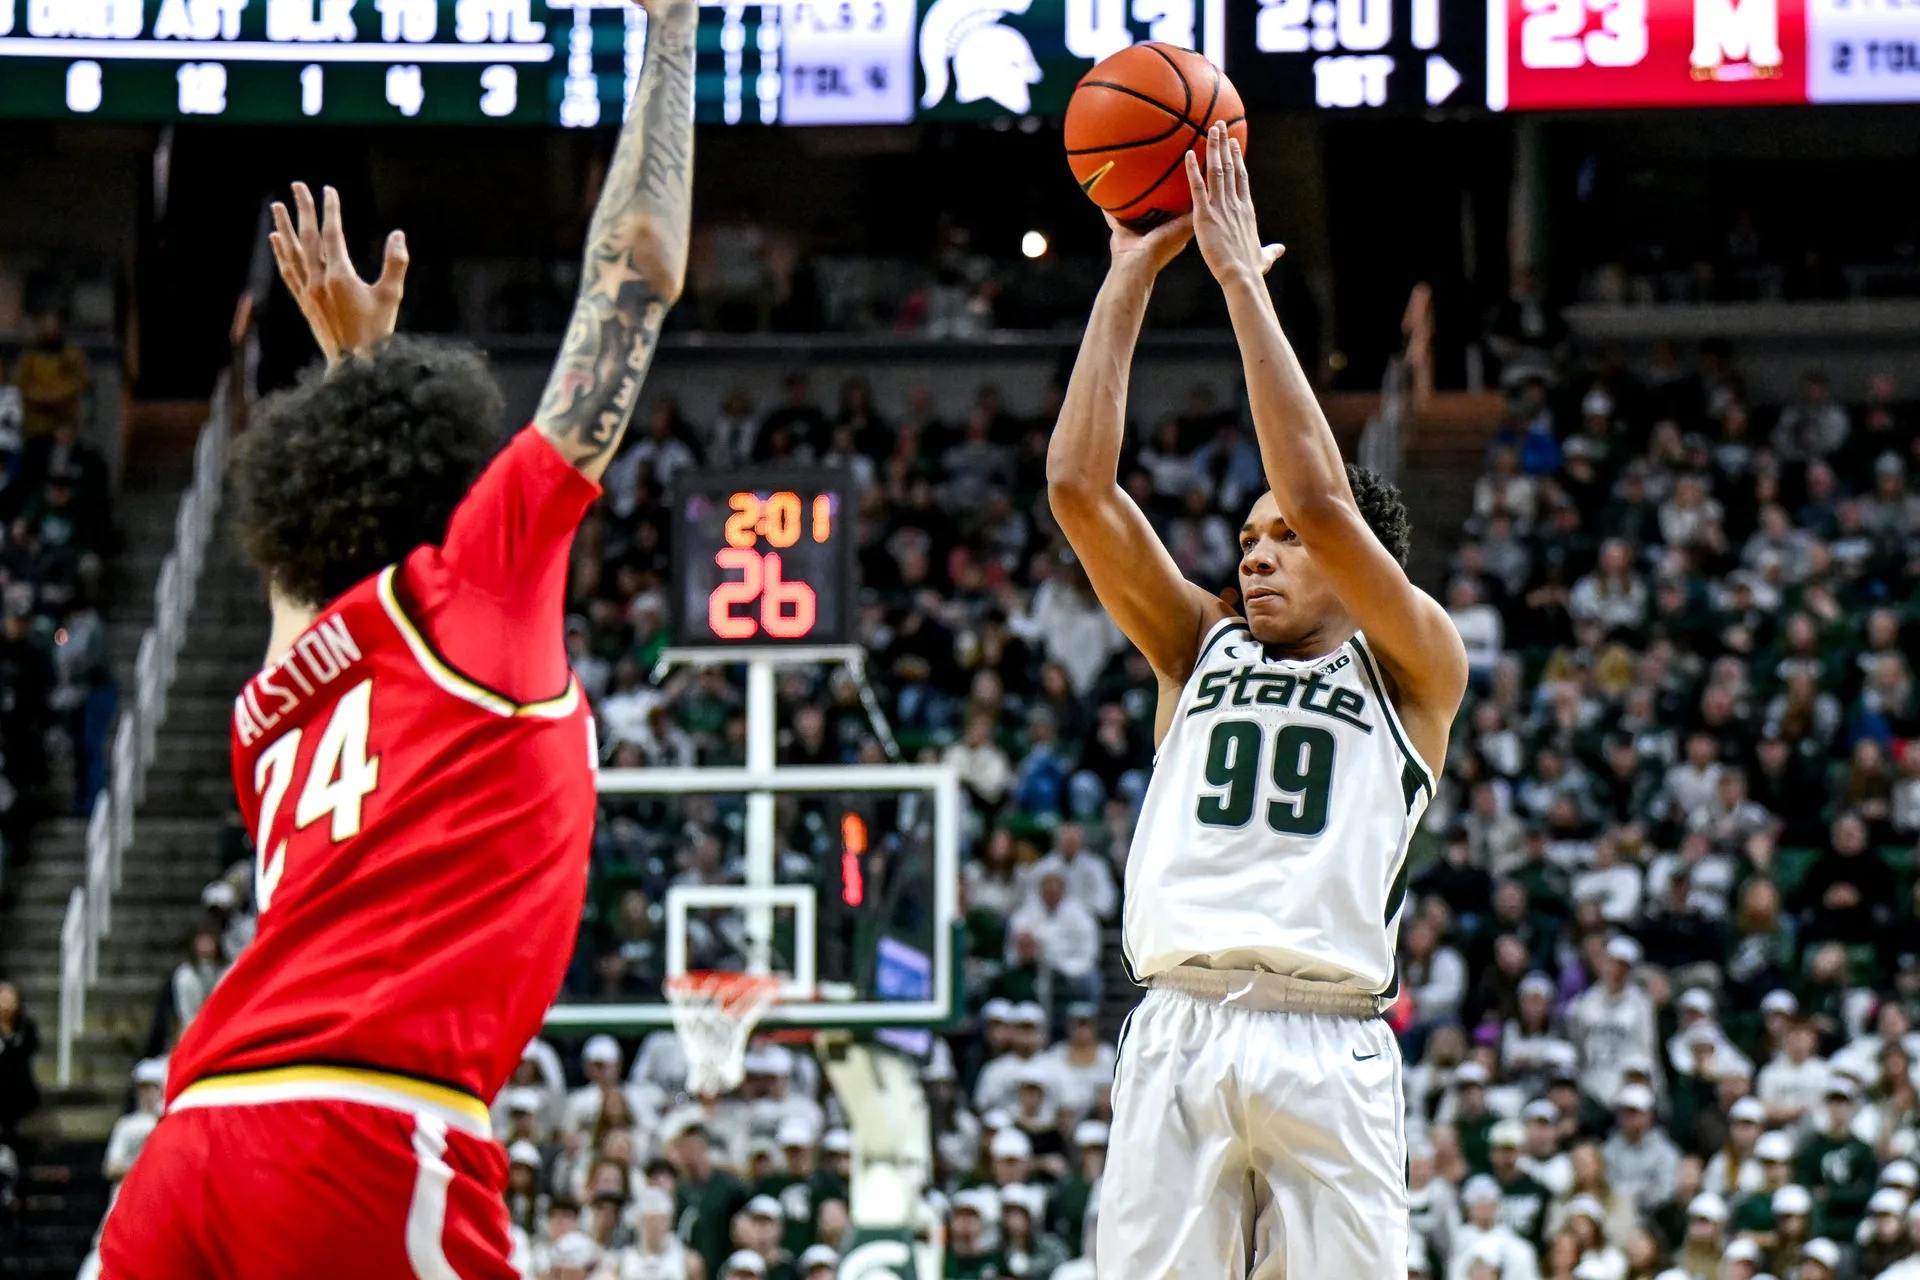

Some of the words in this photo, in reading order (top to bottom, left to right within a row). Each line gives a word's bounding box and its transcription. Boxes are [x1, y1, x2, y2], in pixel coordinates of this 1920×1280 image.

[1521, 0, 1648, 69] 23
[725, 491, 831, 549] 2:01
[709, 547, 817, 639] 26
[234, 612, 362, 748] ALSTON
[1185, 663, 1375, 735] State
[254, 677, 380, 914] 24
[1194, 717, 1339, 840] 99
